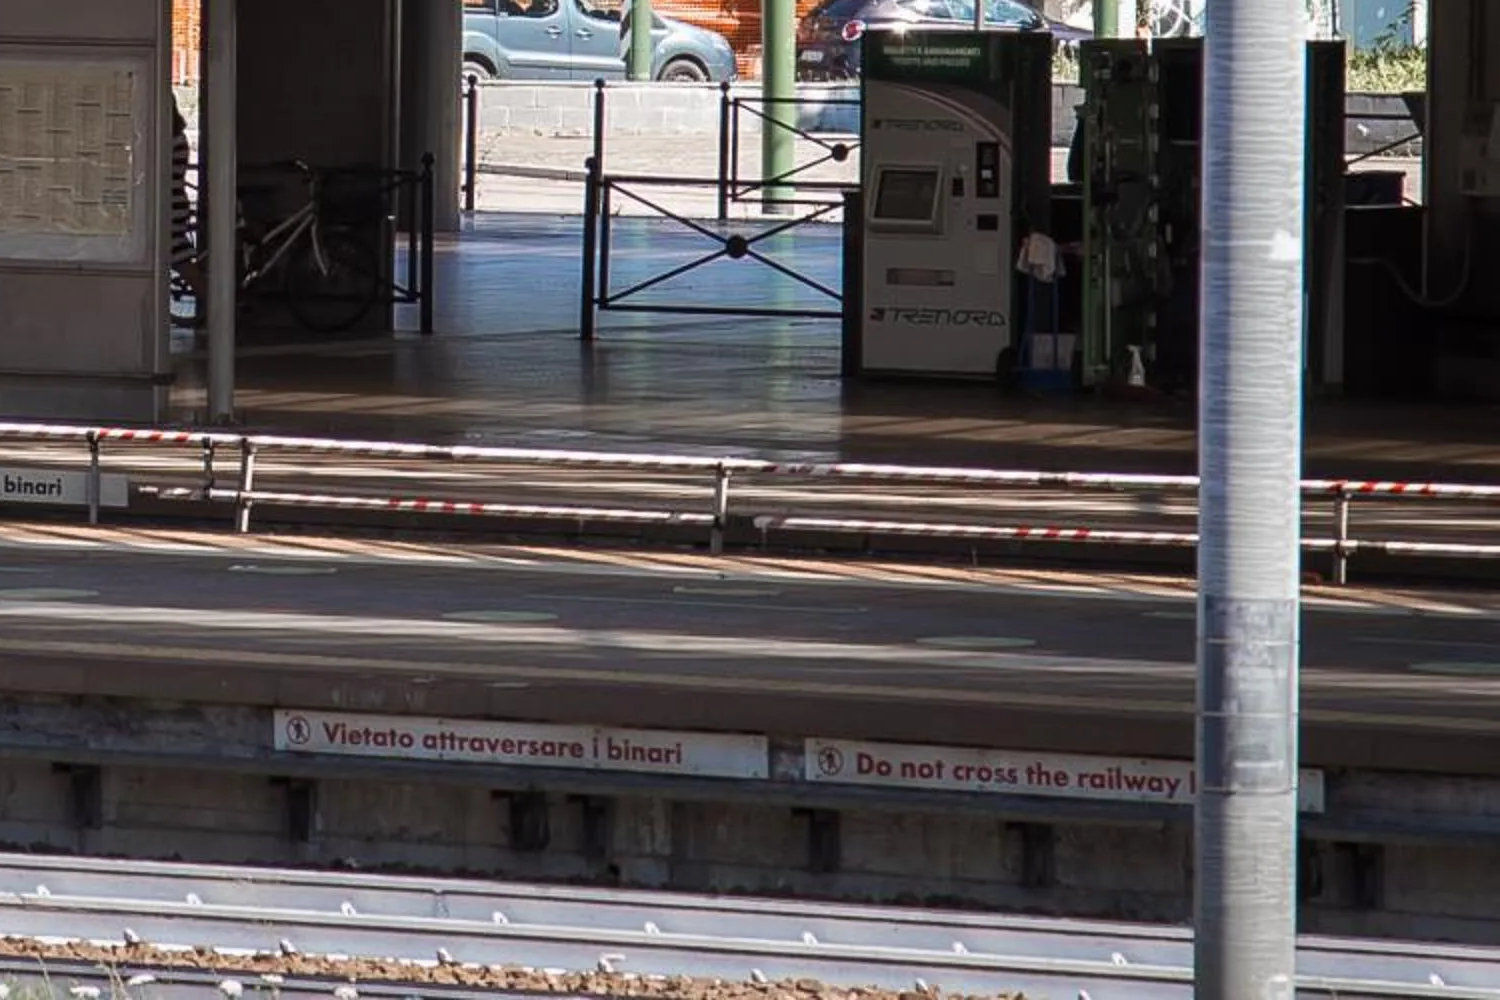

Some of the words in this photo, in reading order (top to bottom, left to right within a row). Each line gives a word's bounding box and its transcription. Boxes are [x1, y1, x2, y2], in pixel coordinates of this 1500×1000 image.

[3, 475, 63, 497] binari
[322, 720, 415, 749] Vietato
[422, 728, 585, 760] attraversare
[606, 737, 682, 765] binari
[855, 752, 892, 778] Do
[899, 757, 944, 781] not
[953, 764, 1018, 786] cross
[1025, 762, 1069, 788] the
[1077, 765, 1182, 799] railway
